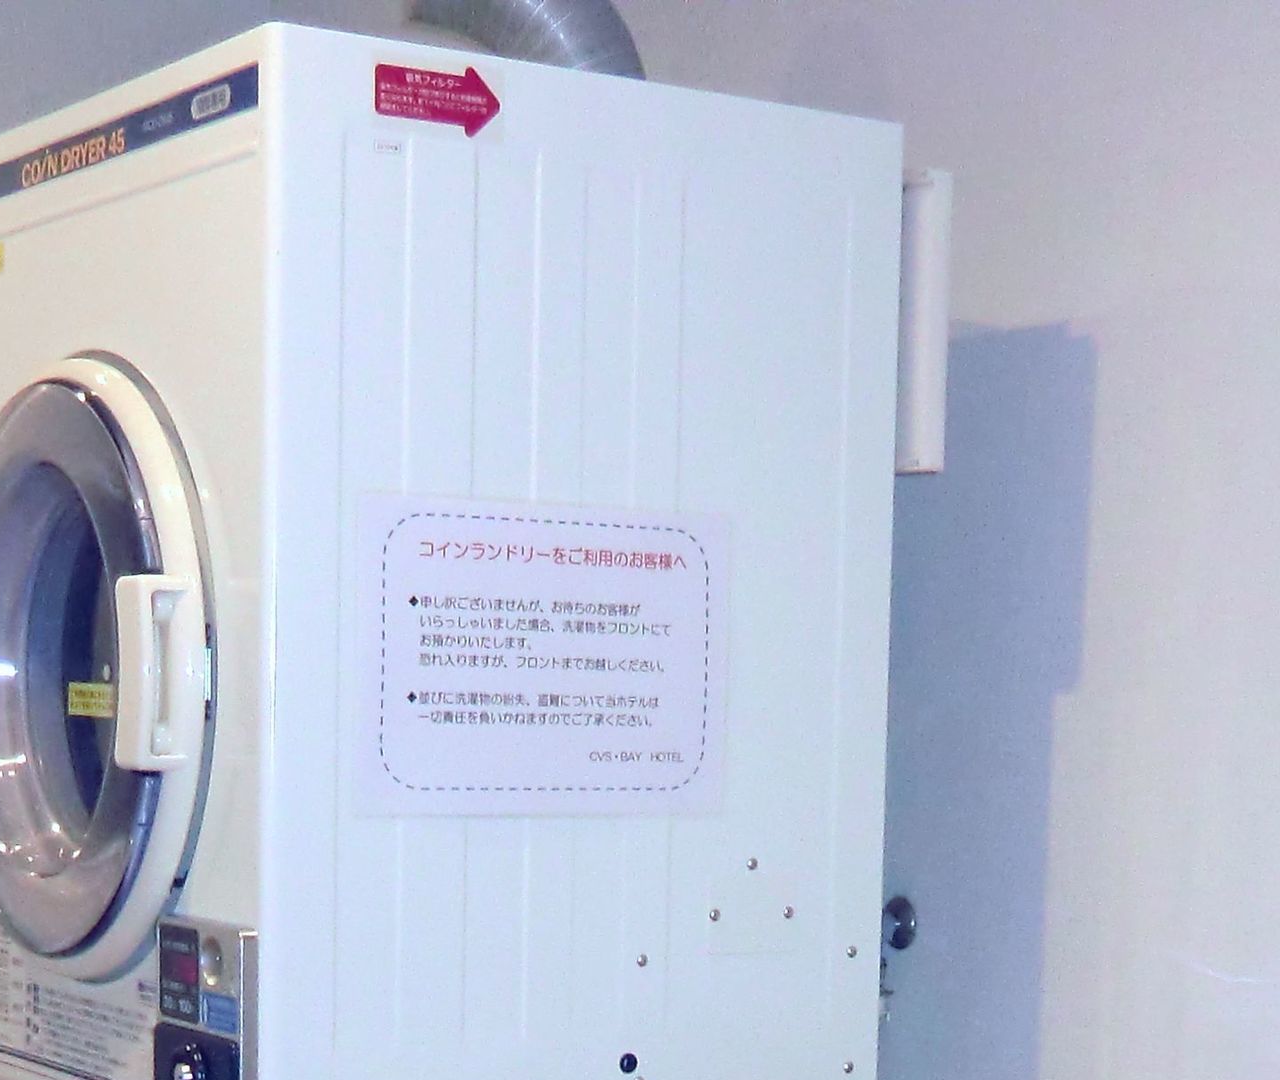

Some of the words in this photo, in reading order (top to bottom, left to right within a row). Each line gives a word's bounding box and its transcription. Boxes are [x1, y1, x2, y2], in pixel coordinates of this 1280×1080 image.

[60, 133, 106, 173] DRYER
[108, 127, 126, 157] 45
[418, 541, 688, 571] コインランドリーをご利用のお客様へ
[649, 752, 684, 763] HOTEL
